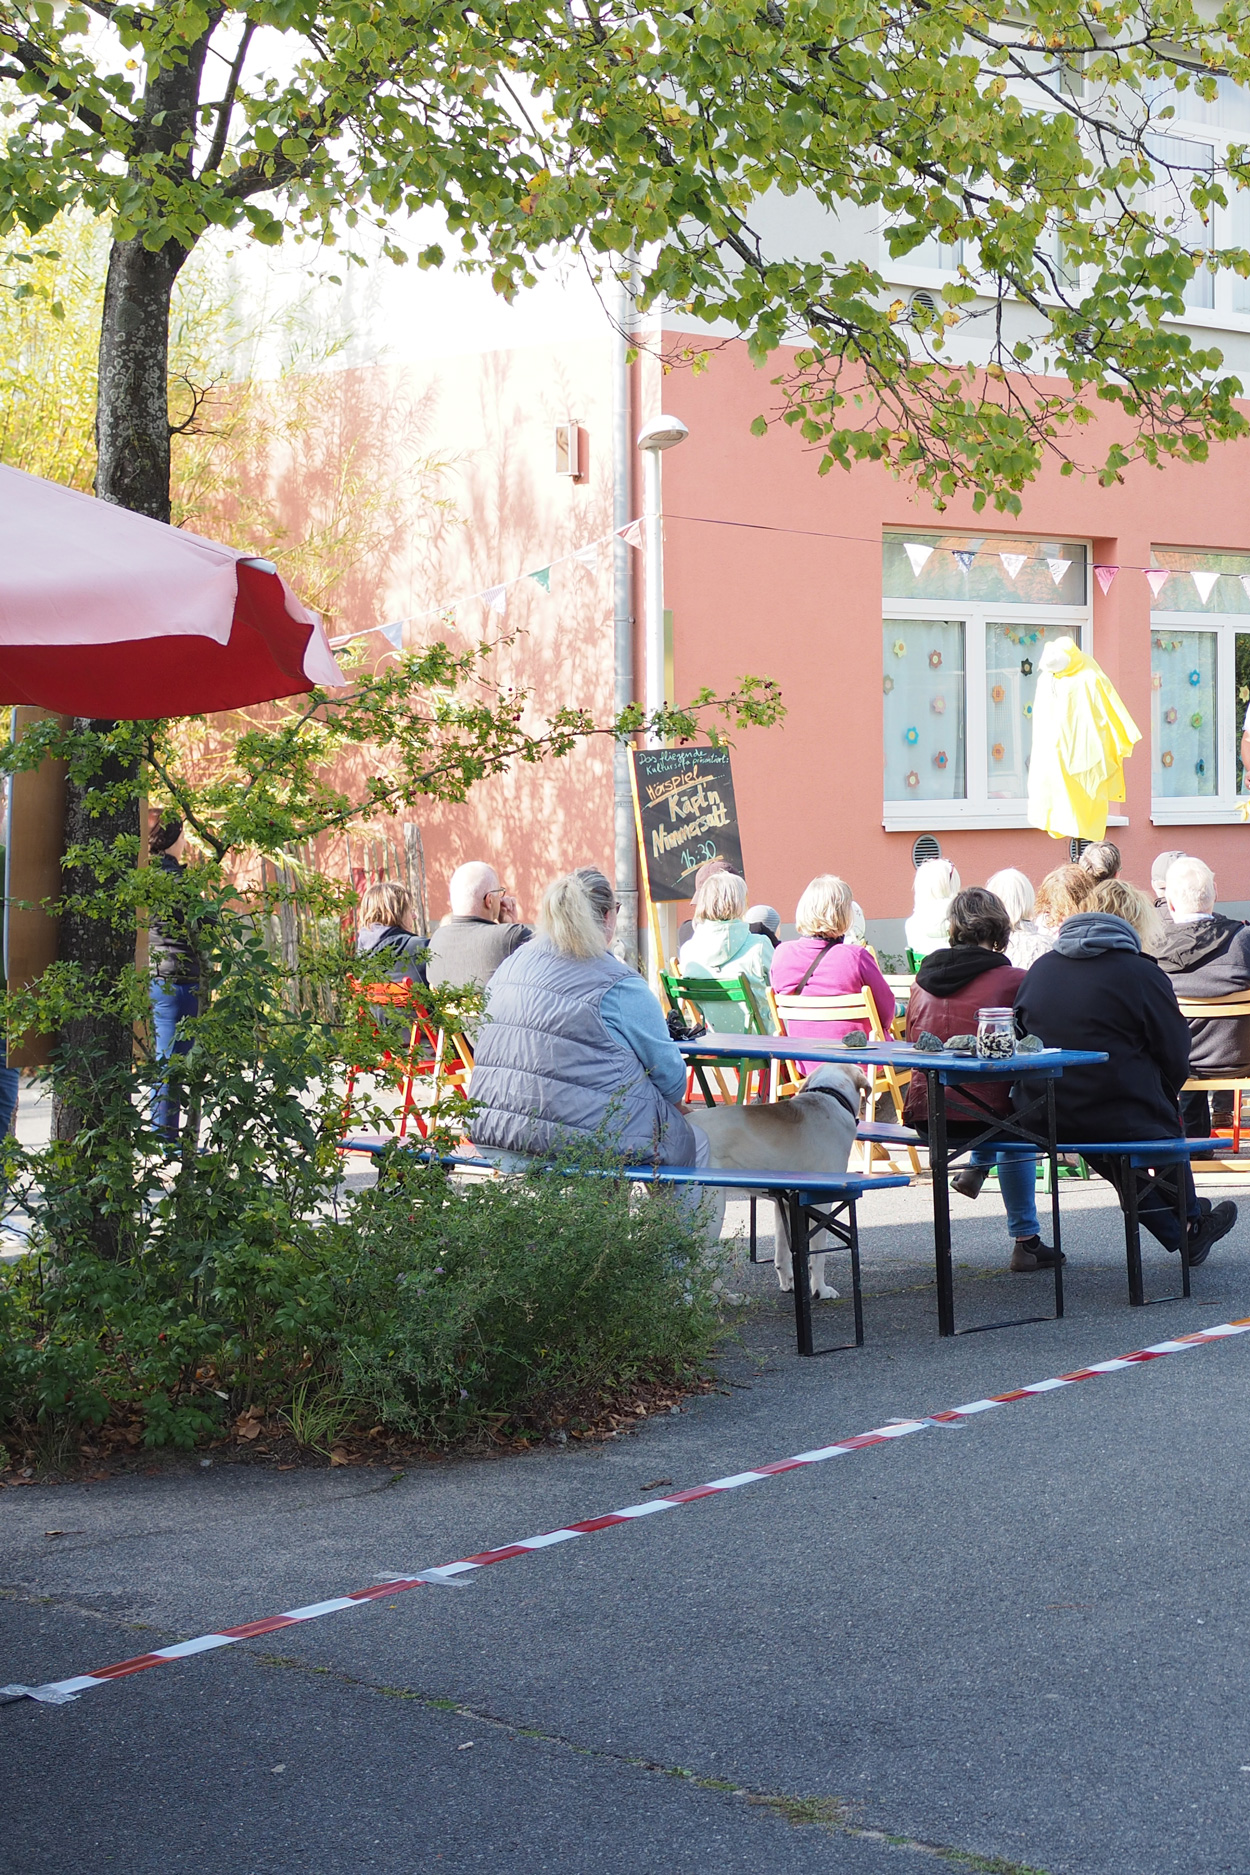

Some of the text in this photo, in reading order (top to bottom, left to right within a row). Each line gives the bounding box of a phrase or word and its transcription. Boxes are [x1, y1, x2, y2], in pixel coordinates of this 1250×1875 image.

[639, 753, 657, 765] Das
[645, 764, 703, 801] Hörspiel
[668, 782, 721, 822] Käpt'n
[651, 802, 731, 858] Nimmersatt
[680, 840, 717, 870] 16:30
